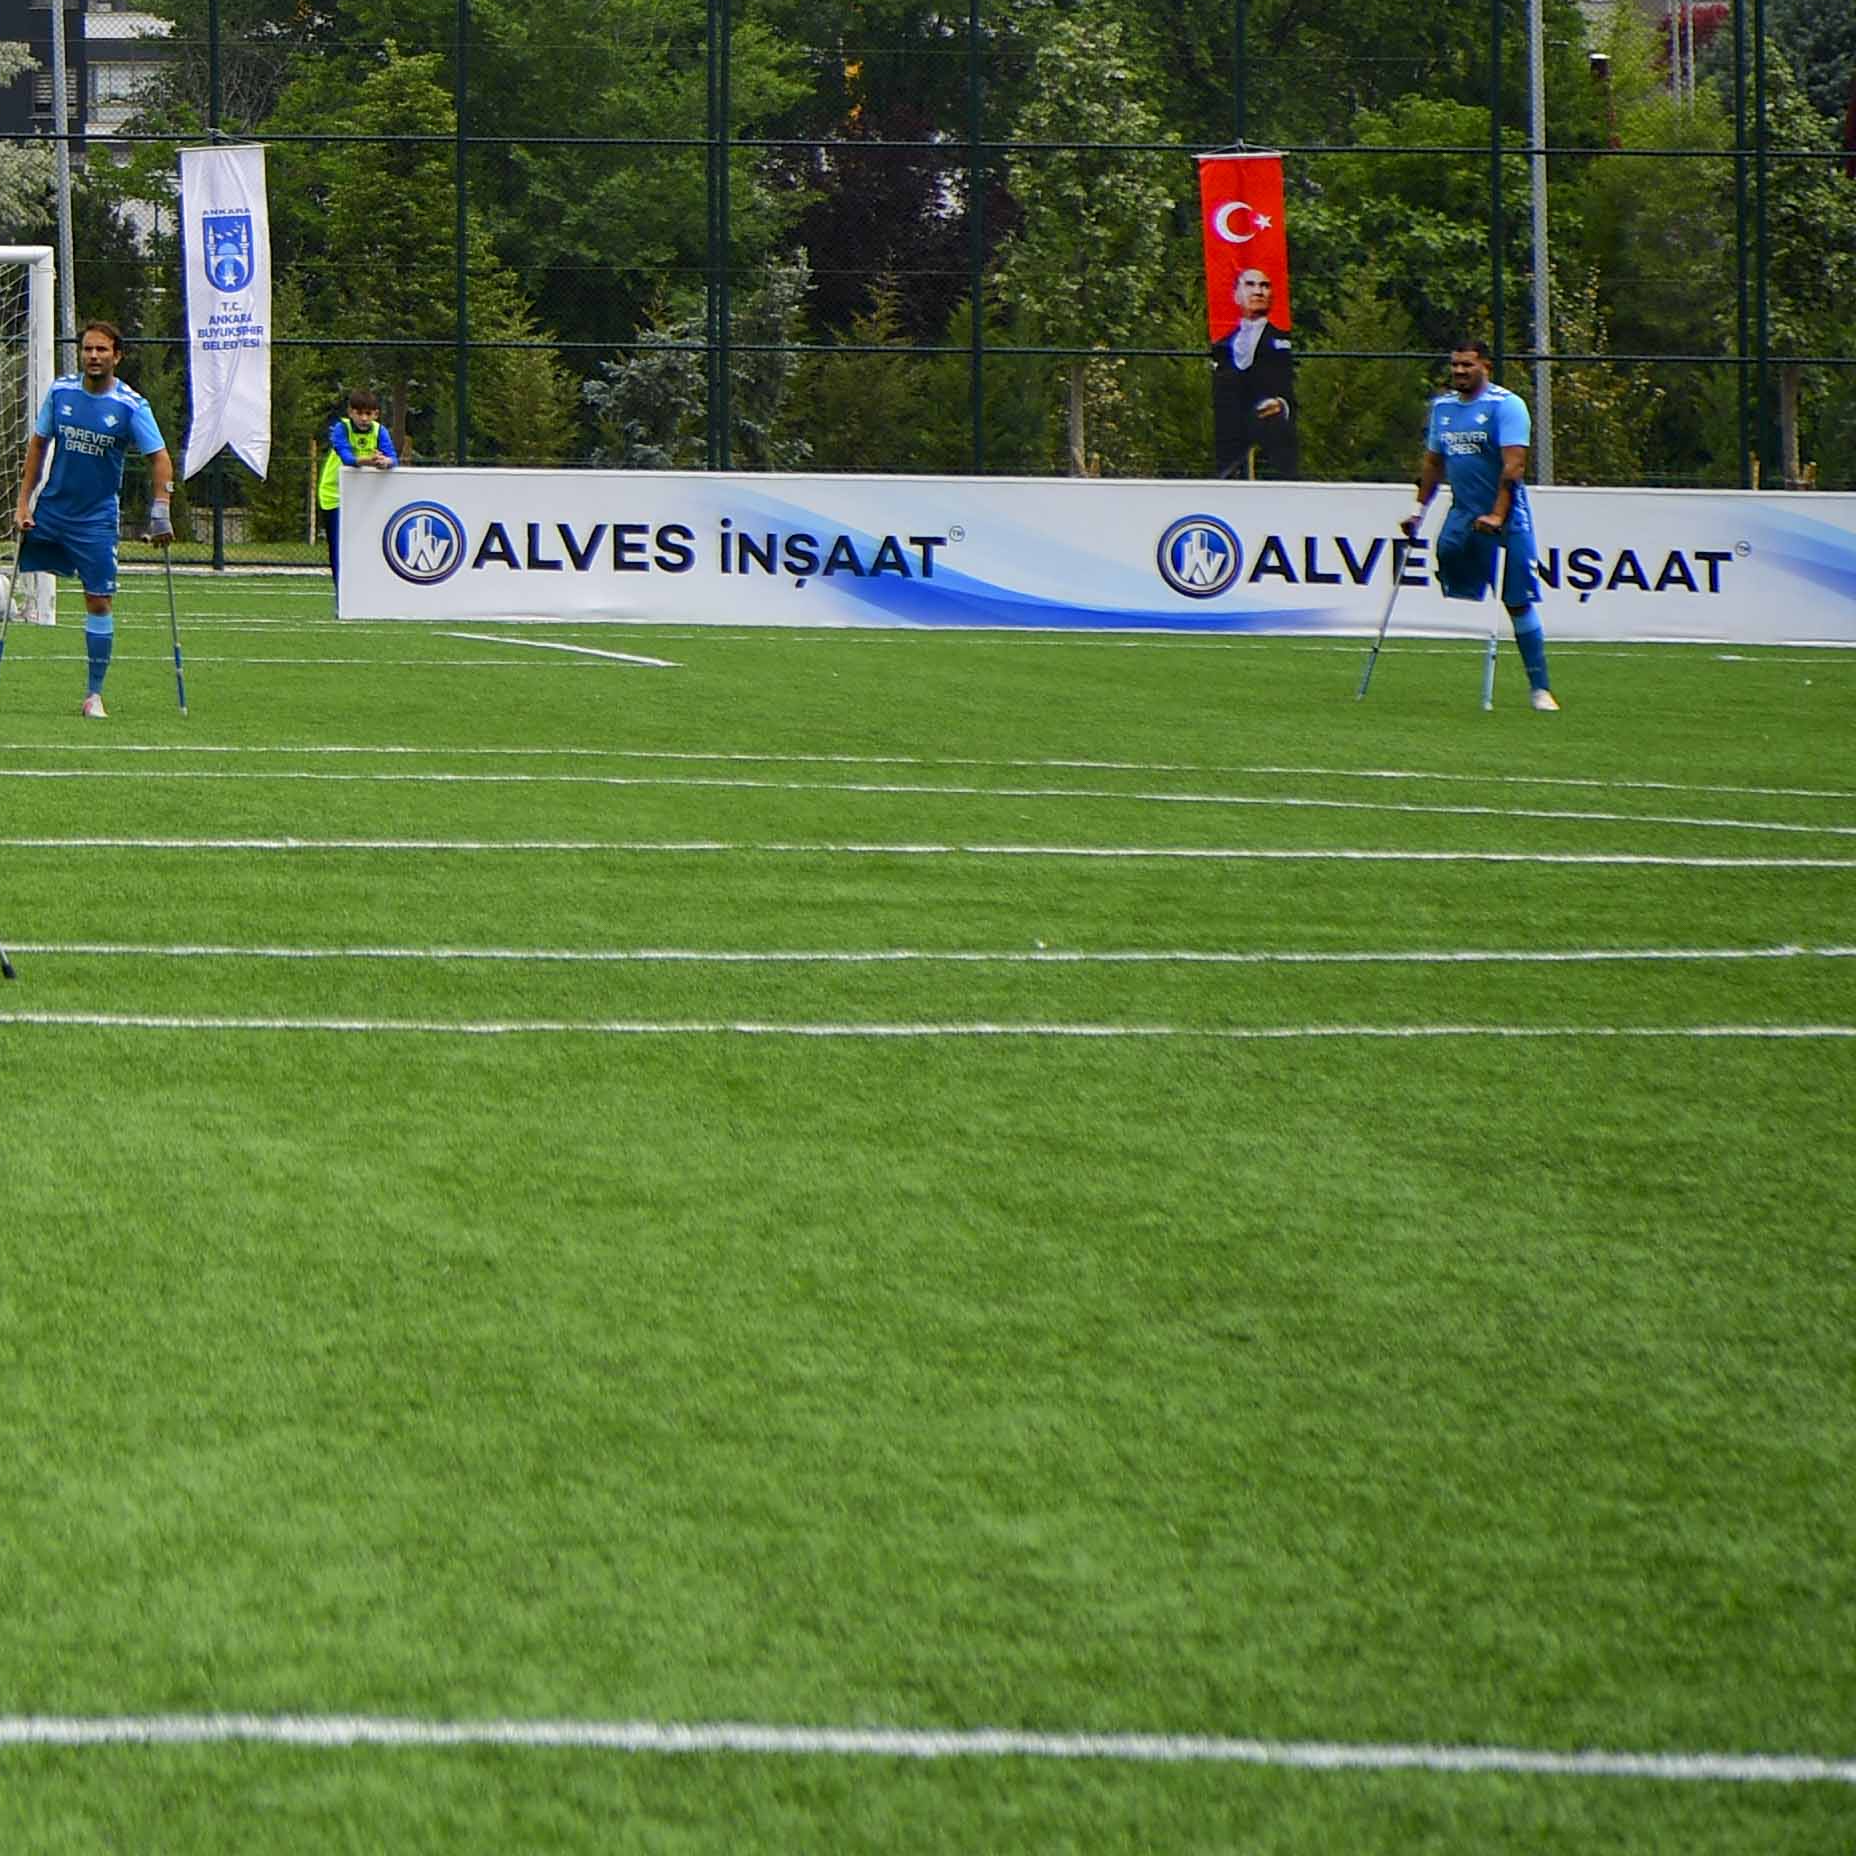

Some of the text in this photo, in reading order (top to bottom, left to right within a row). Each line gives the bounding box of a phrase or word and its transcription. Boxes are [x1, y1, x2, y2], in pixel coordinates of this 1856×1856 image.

[202, 208, 250, 216] ANKARA
[208, 313, 253, 325] ANKARA
[58, 424, 116, 448] FOREVER
[65, 439, 105, 456] GREEN
[471, 521, 697, 574] ALVES
[1248, 534, 1430, 586] ALVE
[1535, 546, 1734, 603] NŞAAT
